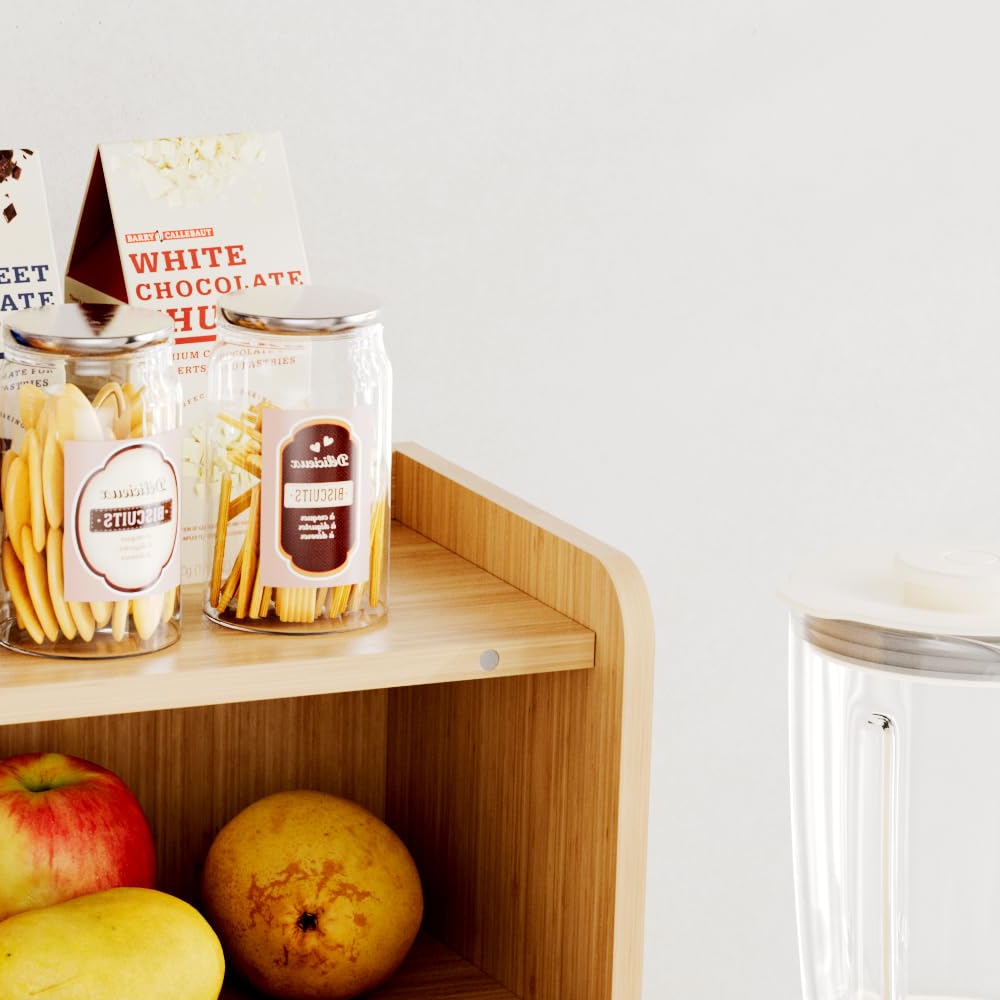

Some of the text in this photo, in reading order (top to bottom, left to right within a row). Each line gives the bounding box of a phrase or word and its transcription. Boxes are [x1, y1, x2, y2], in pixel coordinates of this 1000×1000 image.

[127, 229, 213, 243] BARRY CALLEBAUT
[128, 244, 247, 274] WHITE
[135, 270, 304, 301] CHOCOLATE
